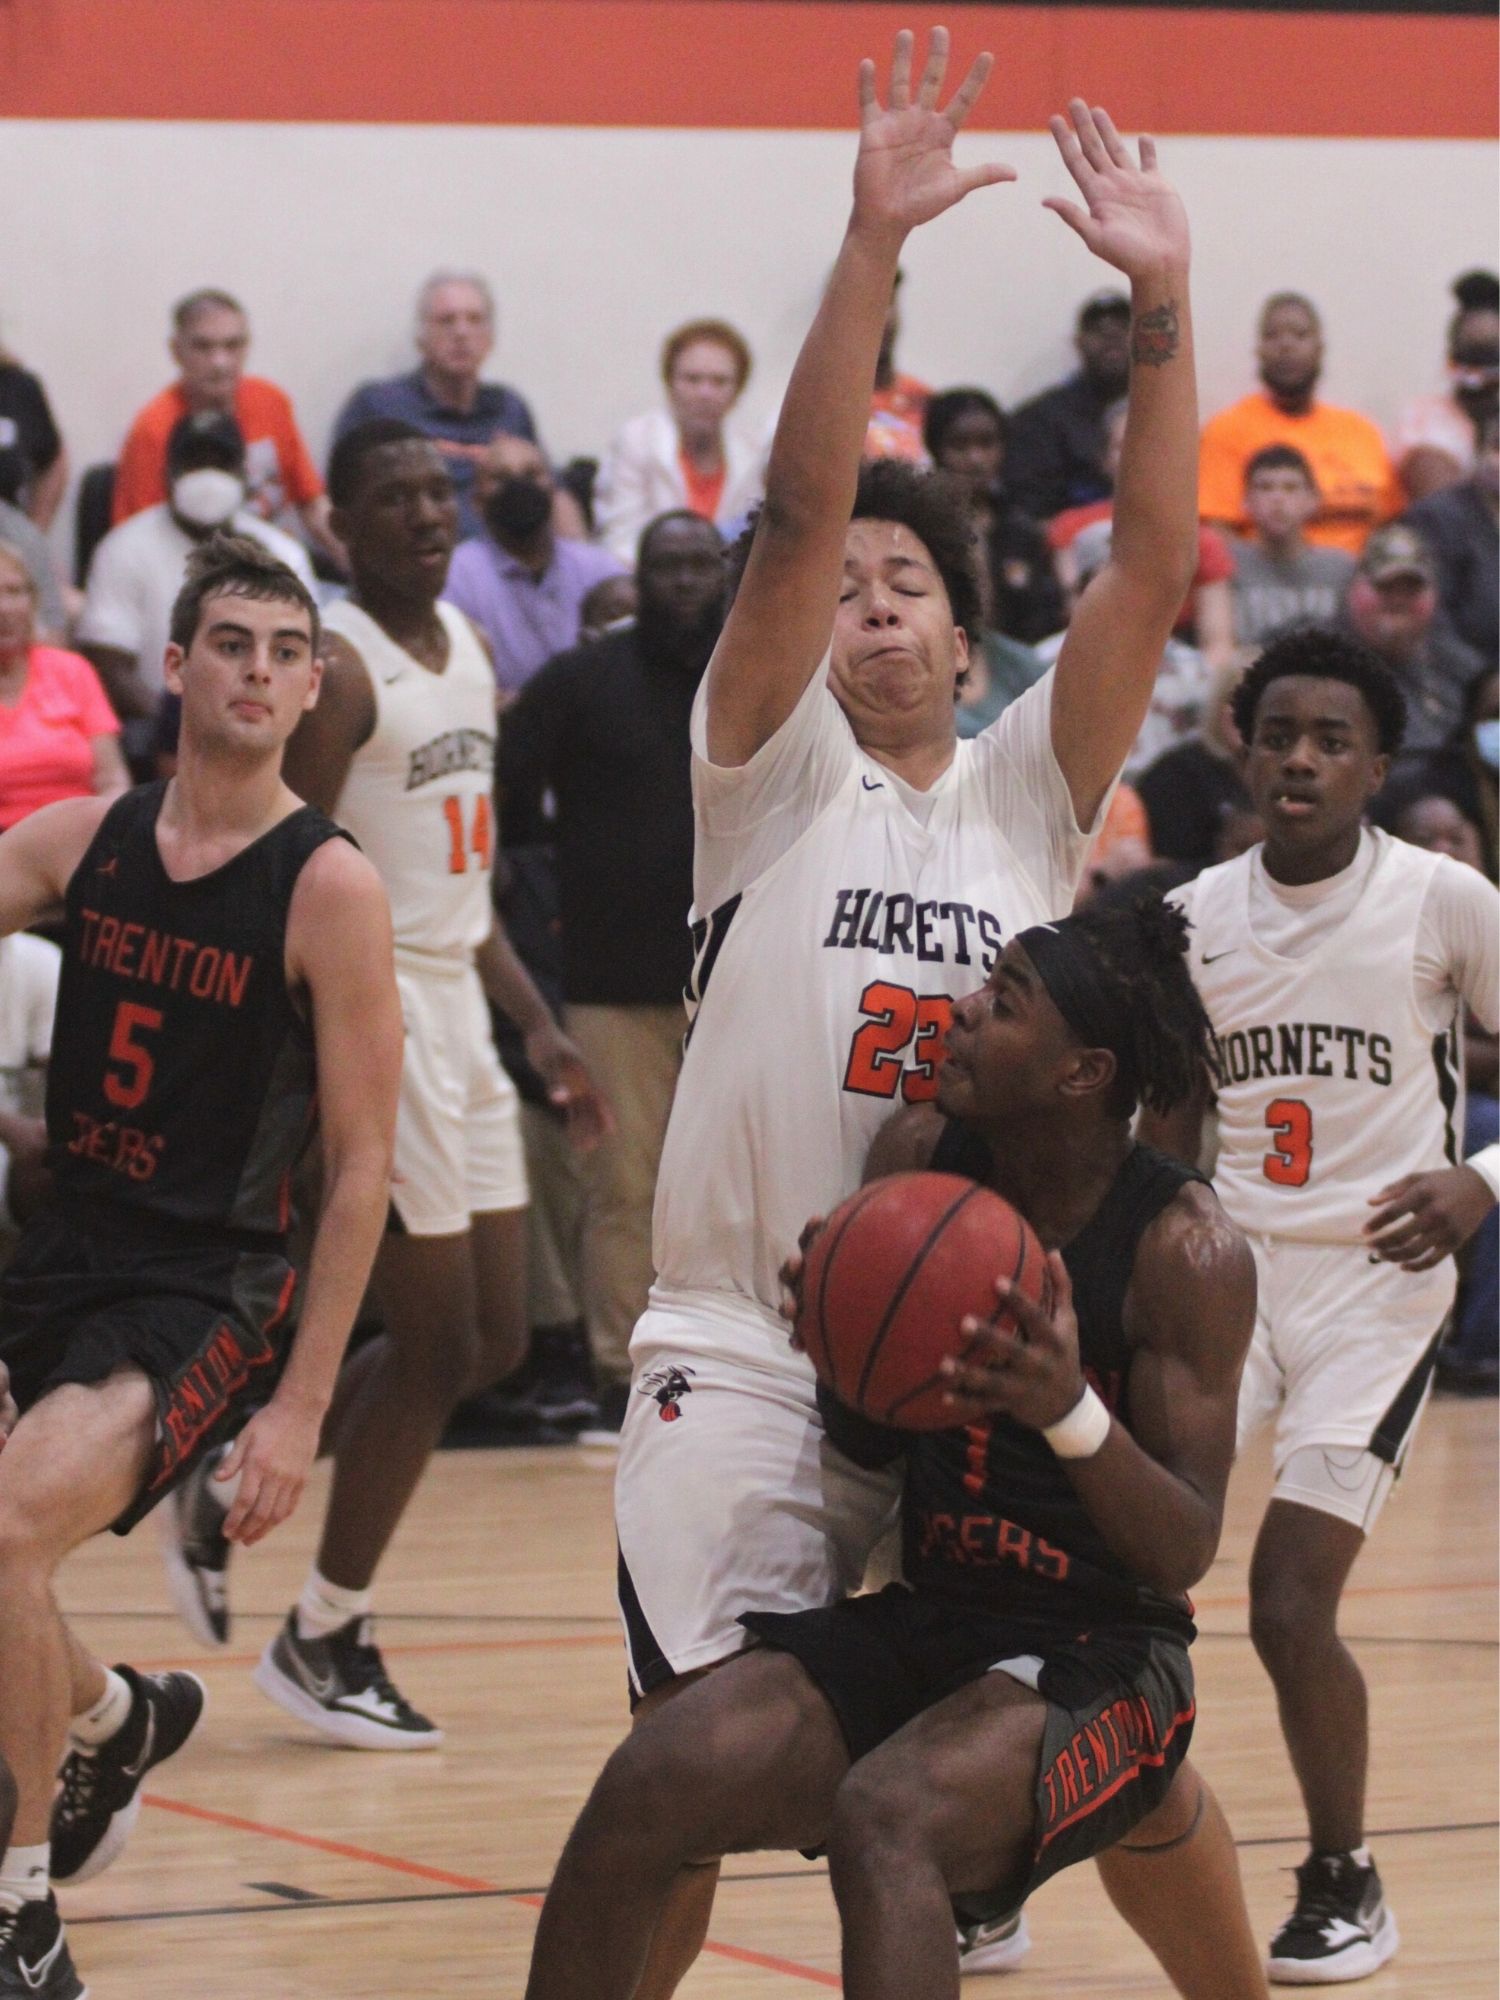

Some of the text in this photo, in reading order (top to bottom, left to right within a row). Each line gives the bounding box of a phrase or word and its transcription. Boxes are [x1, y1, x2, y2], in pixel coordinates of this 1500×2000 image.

[81, 907, 253, 1009] TRENTON
[103, 1001, 163, 1110] 5
[843, 979, 954, 1105] 23
[1263, 1098, 1313, 1188] 3
